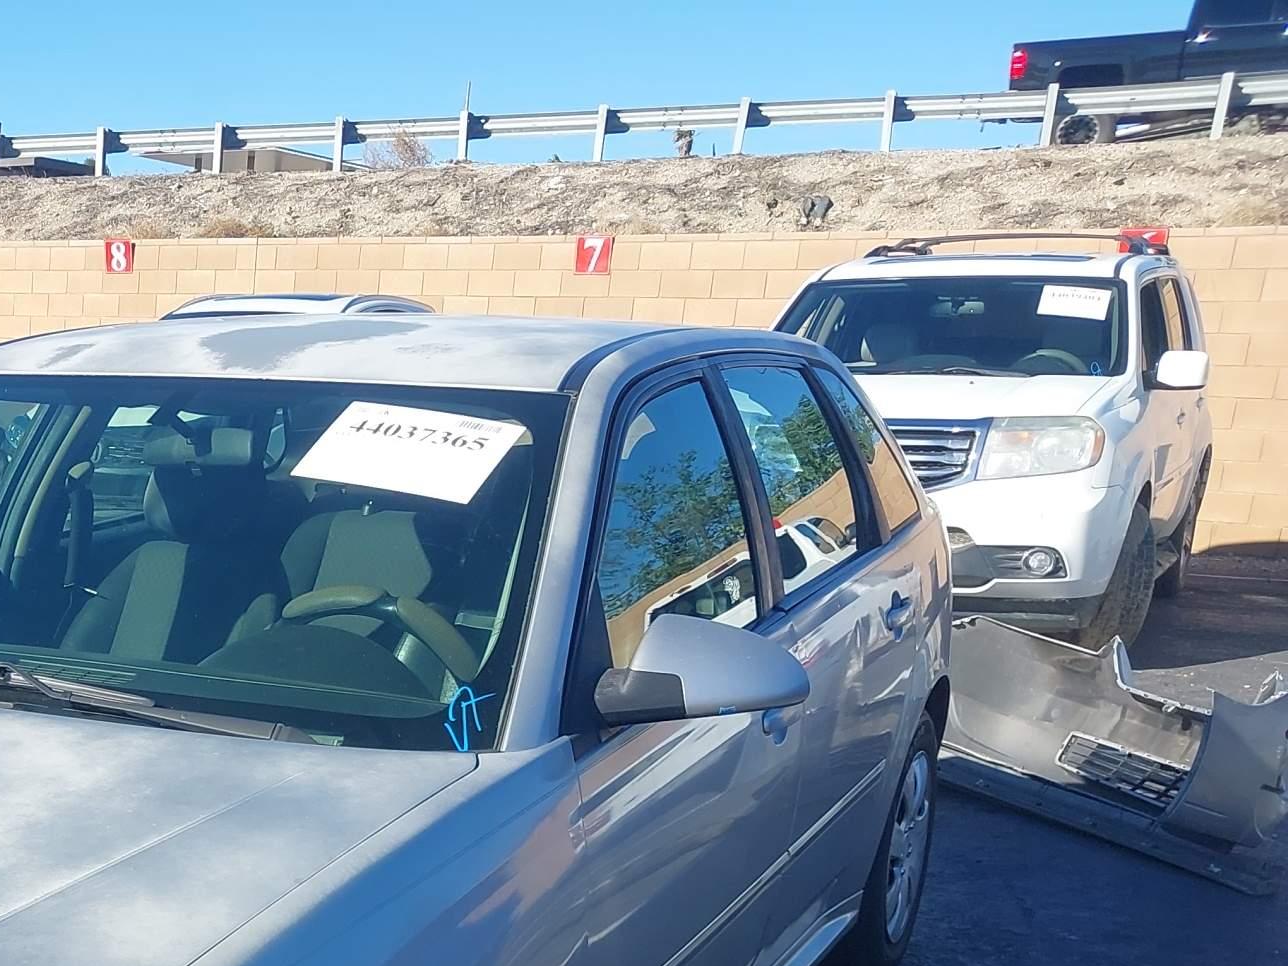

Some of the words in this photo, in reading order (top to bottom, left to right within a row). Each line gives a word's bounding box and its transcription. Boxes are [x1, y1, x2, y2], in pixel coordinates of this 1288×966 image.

[110, 242, 128, 272] 8
[583, 239, 605, 272] 7
[349, 419, 490, 451] 44037365
